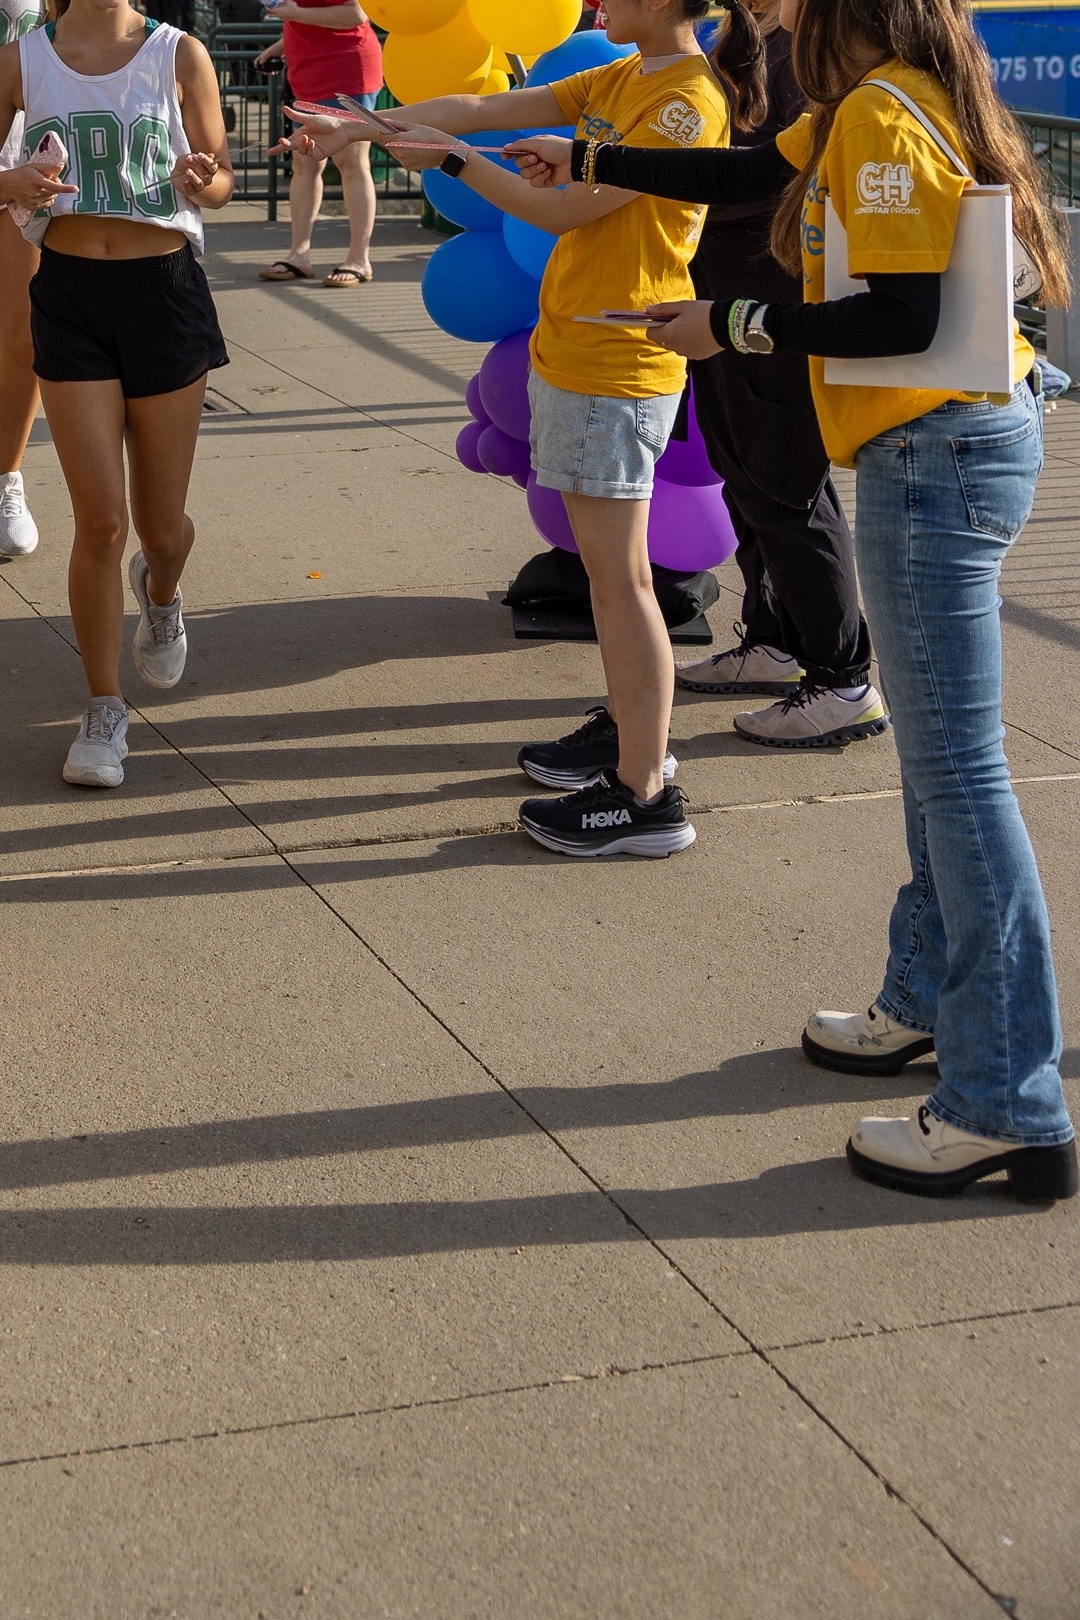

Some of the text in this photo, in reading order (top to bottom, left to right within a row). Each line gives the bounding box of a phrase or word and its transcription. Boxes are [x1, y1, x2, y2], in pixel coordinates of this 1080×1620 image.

[1033, 55, 1065, 81] TO
[648, 122, 676, 141] LONESTAR
[855, 206, 921, 215] LONESTAR PROMO
[581, 809, 632, 829] HOKA
